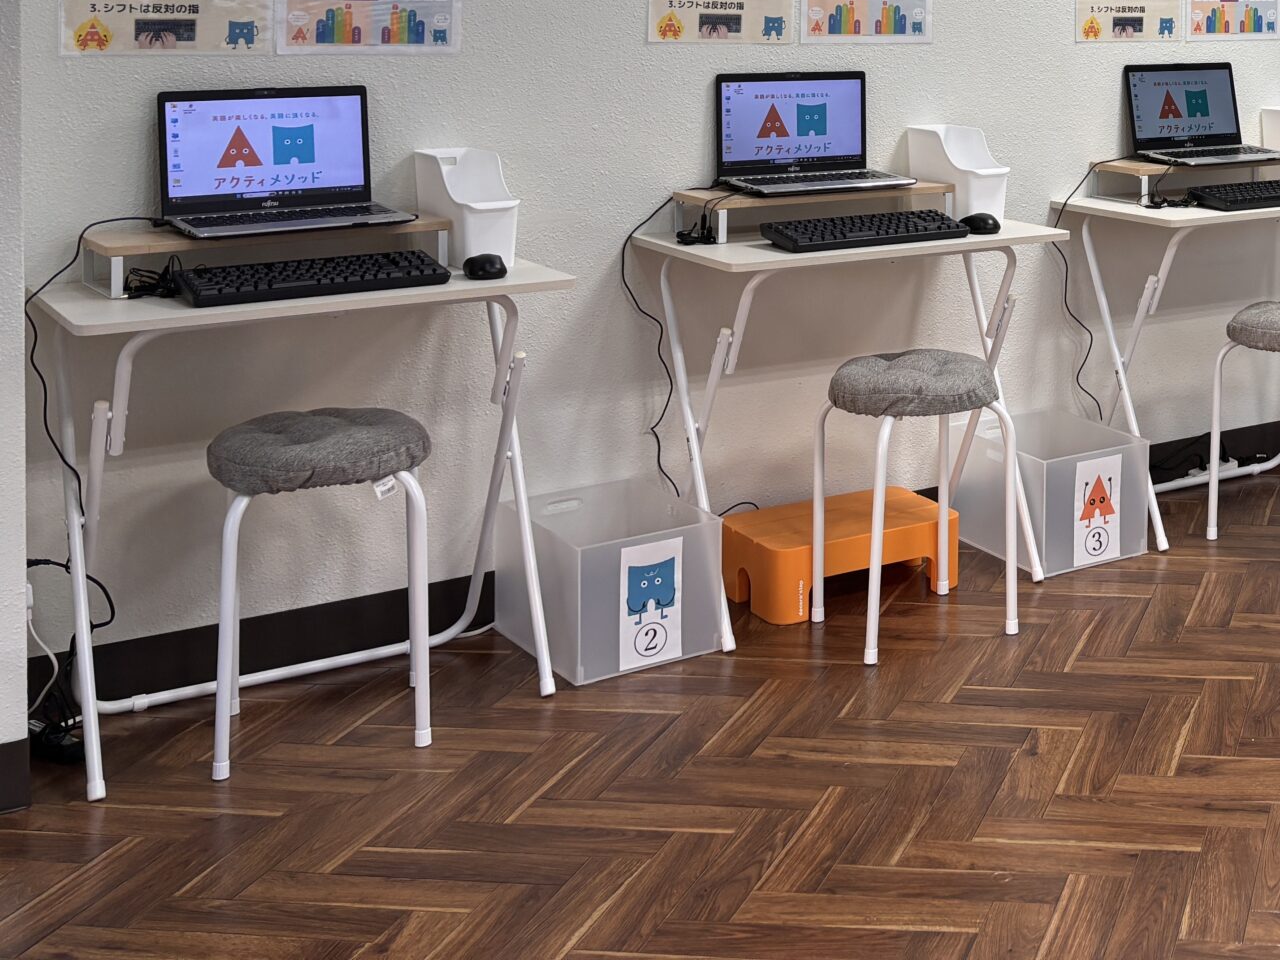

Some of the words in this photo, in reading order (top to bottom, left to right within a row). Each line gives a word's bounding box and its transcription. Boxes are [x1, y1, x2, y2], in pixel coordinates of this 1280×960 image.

[1159, 122, 1215, 134] アクティメソッド
[754, 142, 832, 156] アクティメソッド
[214, 171, 322, 190] アクティメソッド
